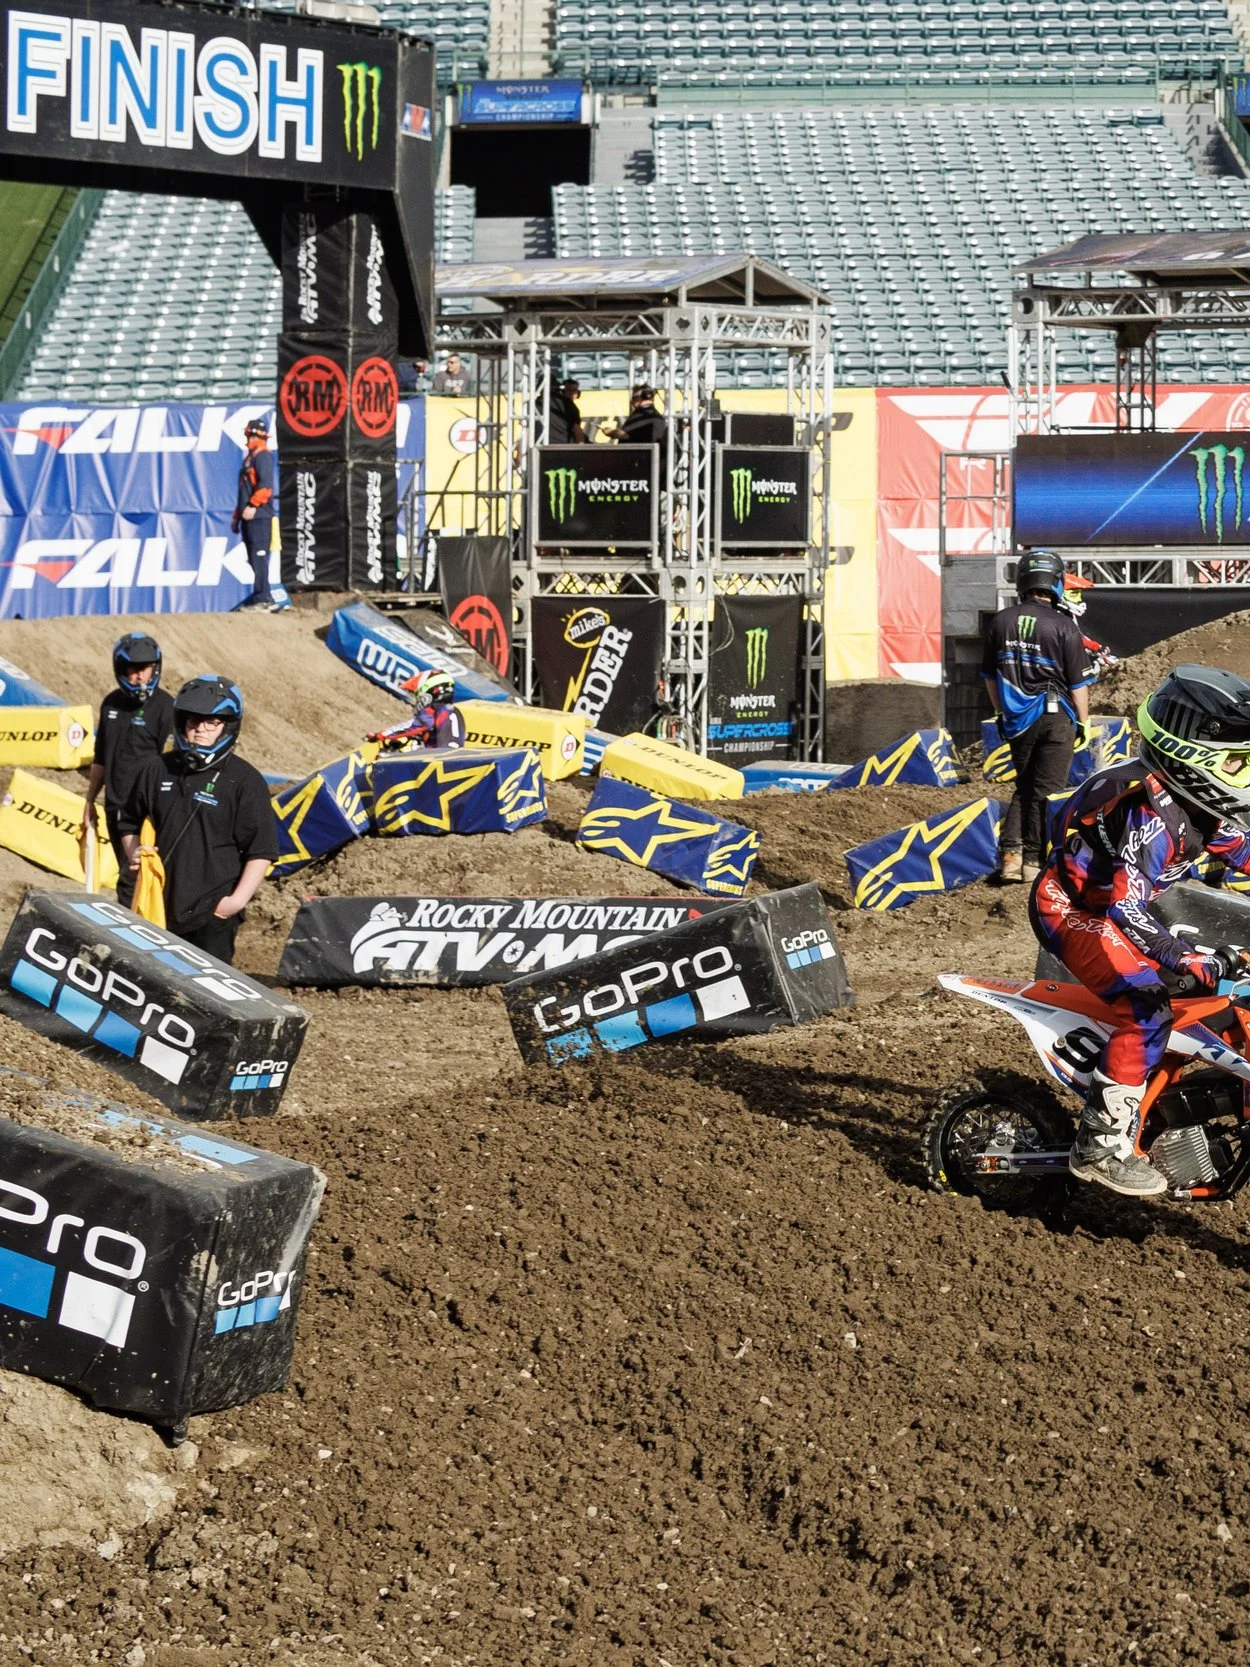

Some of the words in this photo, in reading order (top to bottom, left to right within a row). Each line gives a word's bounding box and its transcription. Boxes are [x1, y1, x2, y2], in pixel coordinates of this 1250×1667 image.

[7, 10, 324, 163] FINISH
[294, 378, 336, 413] RM
[359, 380, 390, 413] RM
[14, 406, 278, 455] FALK
[577, 477, 649, 494] MONSTER
[752, 478, 797, 495] MONSTER
[11, 537, 282, 589] FALK
[569, 614, 607, 640] mike's
[573, 625, 633, 729] RDER
[730, 694, 776, 710] MONSTER
[724, 741, 775, 753] CHAMPIONSHIP
[1150, 729, 1217, 768] 100%
[17, 799, 111, 845] DUNLP
[407, 898, 510, 930] ROCKY
[509, 899, 688, 931] MOUNTAIN
[92, 901, 263, 1001] GoPro
[780, 927, 829, 952] GoPro
[25, 927, 197, 1049] GoPro
[533, 945, 734, 1033] GoPro
[235, 1059, 289, 1075] GoPro
[217, 1269, 297, 1307] GoPr
